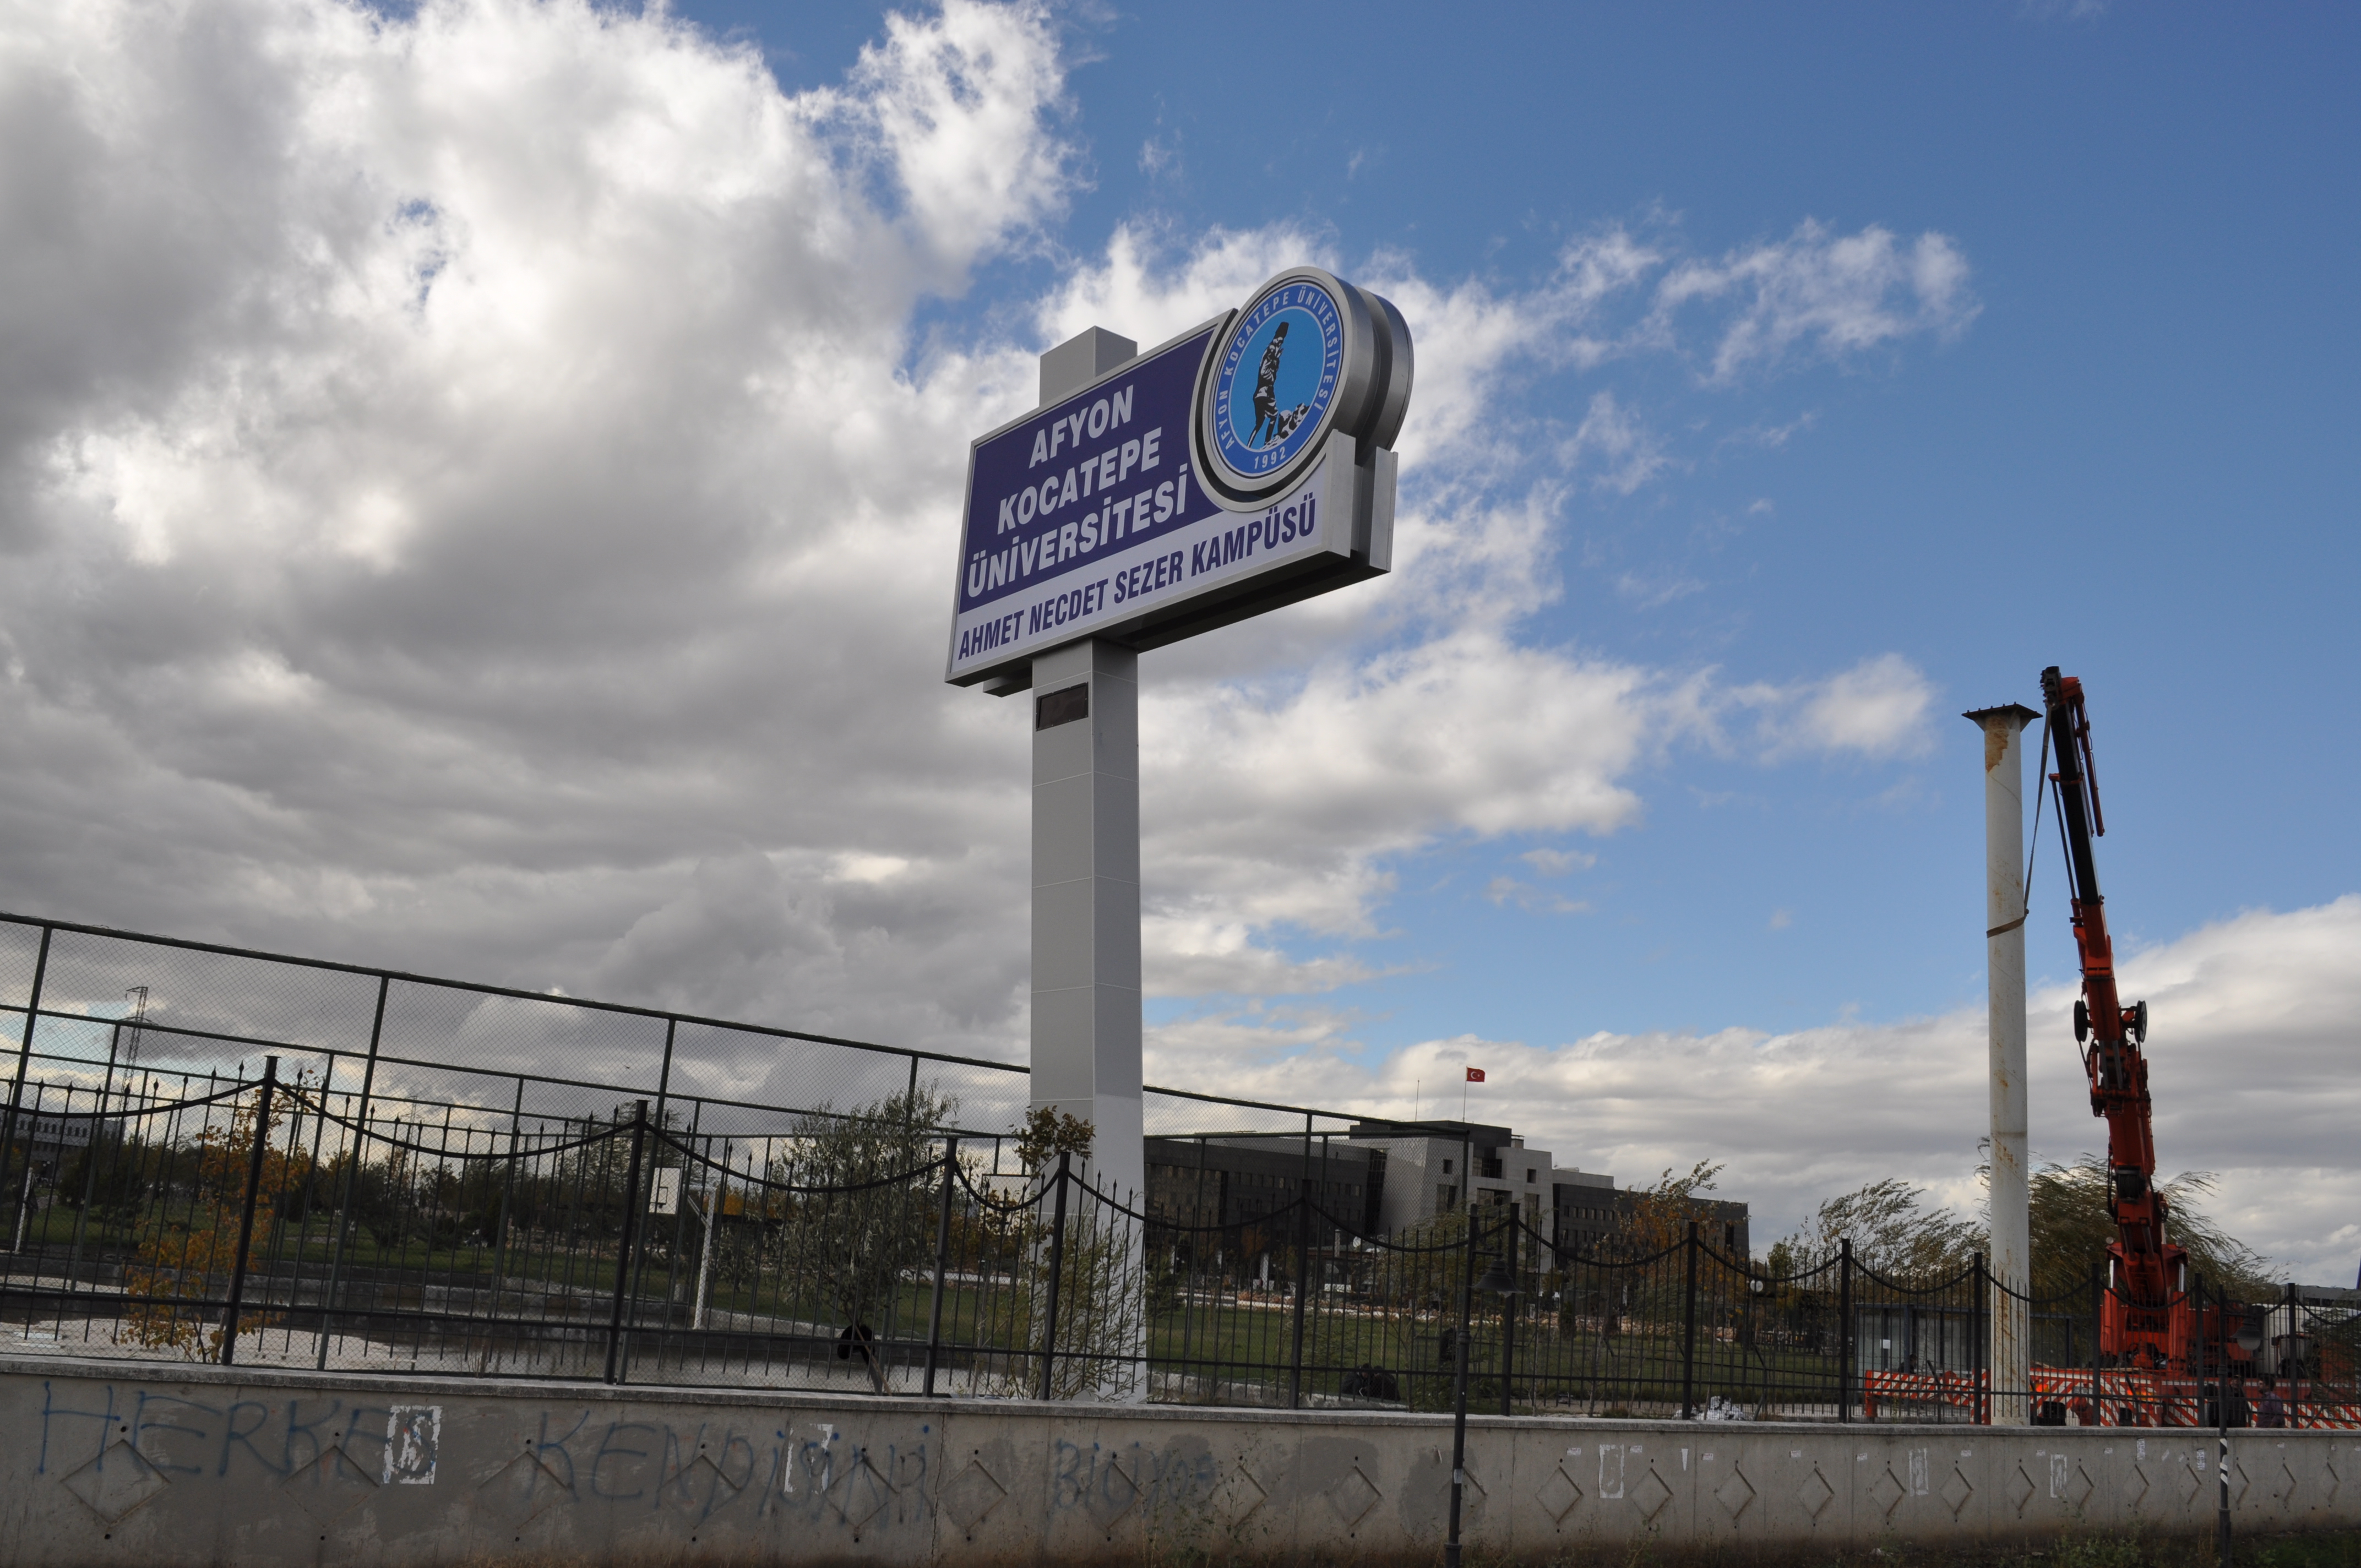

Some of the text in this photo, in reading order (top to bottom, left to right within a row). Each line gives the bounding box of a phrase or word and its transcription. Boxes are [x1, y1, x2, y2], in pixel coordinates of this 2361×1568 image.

[1223, 291, 1290, 376] KOCATEPE
[1028, 384, 1134, 469] AFYON
[1218, 390, 1235, 450] AFYON
[1254, 446, 1286, 469] 1992
[997, 426, 1162, 535] KOCATEPE
[958, 491, 1316, 661] AHMET NECDET SEZER KAMPÜSÜ
[967, 462, 1188, 598] ÜNİVERSİTESİ
[39, 1381, 437, 1485] HERKES
